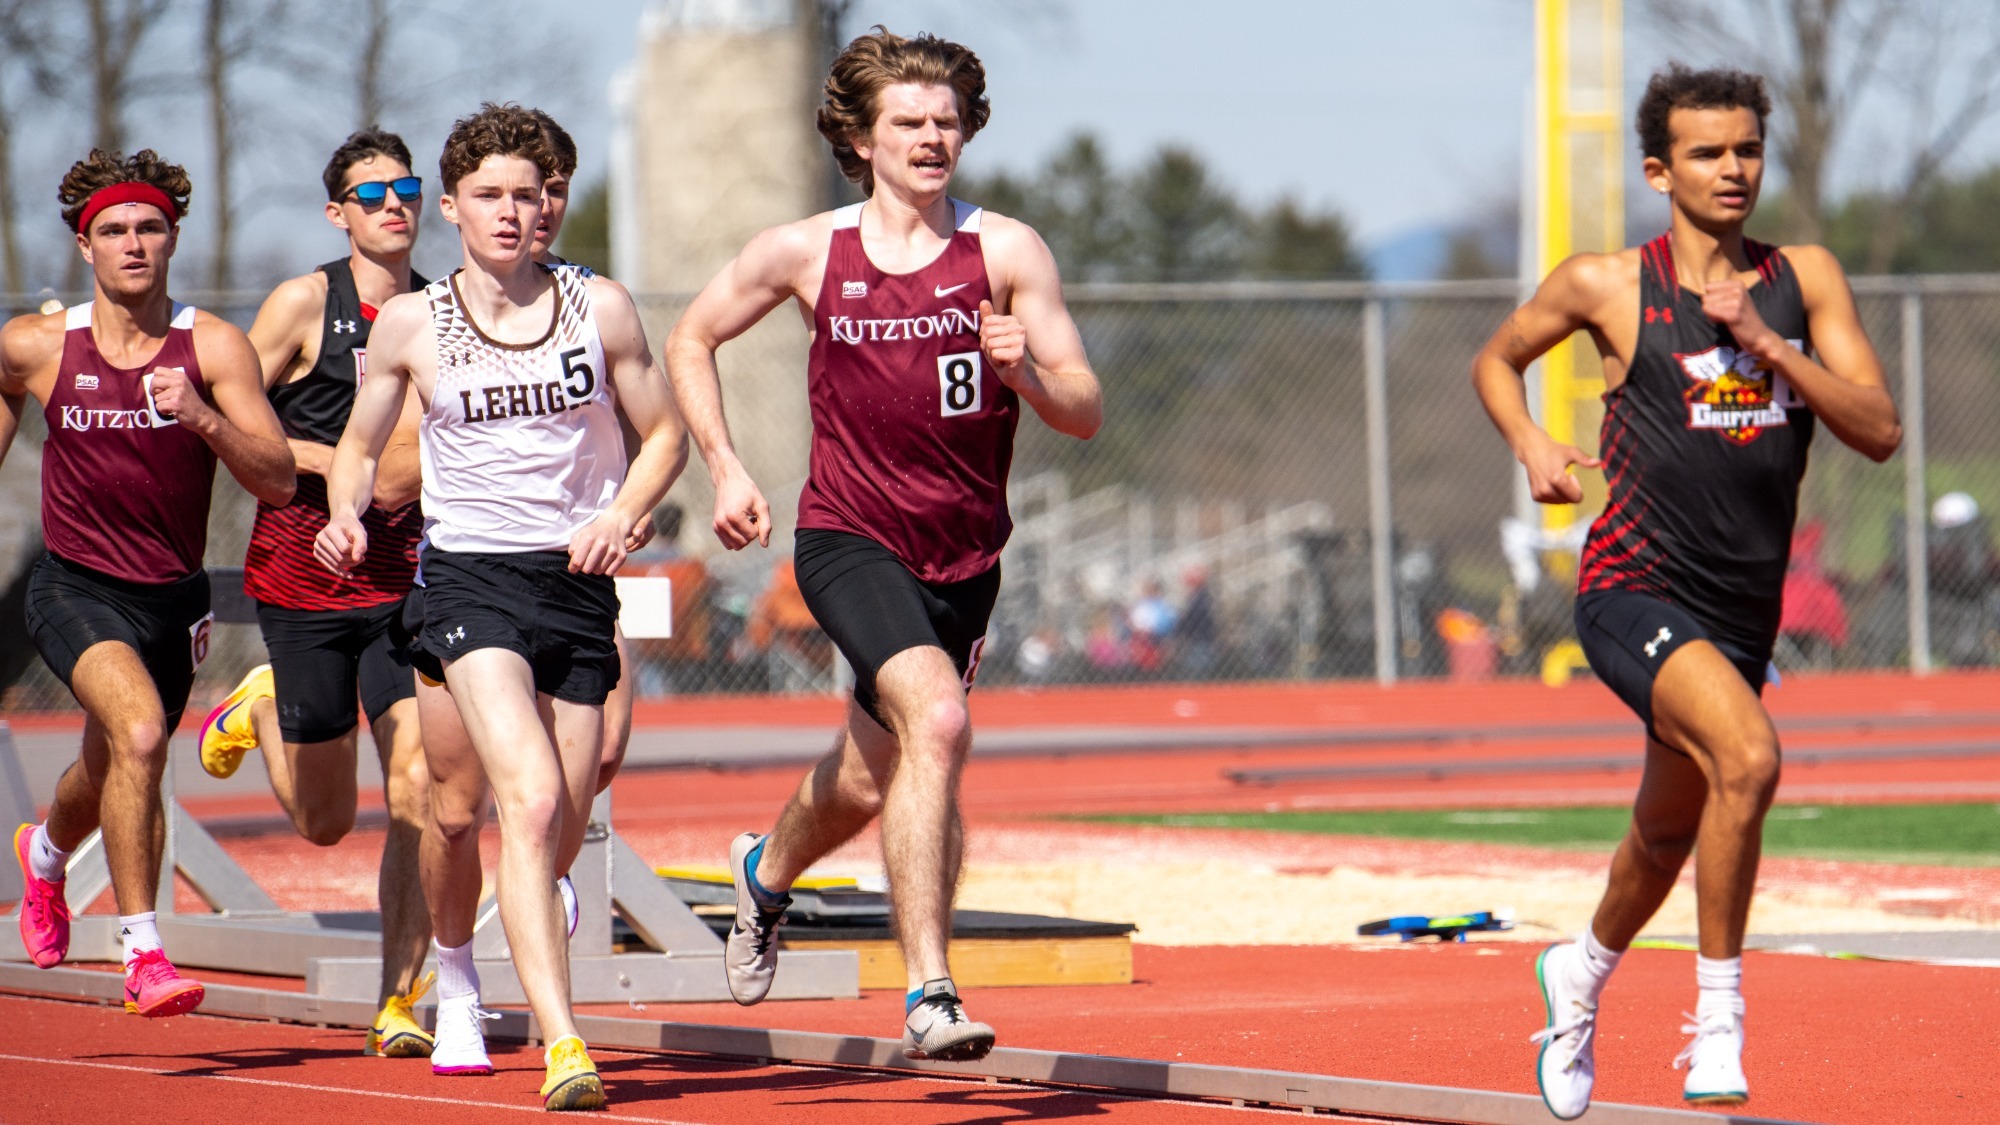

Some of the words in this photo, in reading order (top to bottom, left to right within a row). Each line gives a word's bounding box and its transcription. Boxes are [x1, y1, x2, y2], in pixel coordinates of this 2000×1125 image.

[829, 308, 980, 345] KUTZTOWN
[560, 346, 594, 398] 5
[945, 358, 975, 411] 8
[60, 405, 152, 432] KUTZTO
[459, 381, 592, 423] LEHIG
[194, 619, 211, 665] 6
